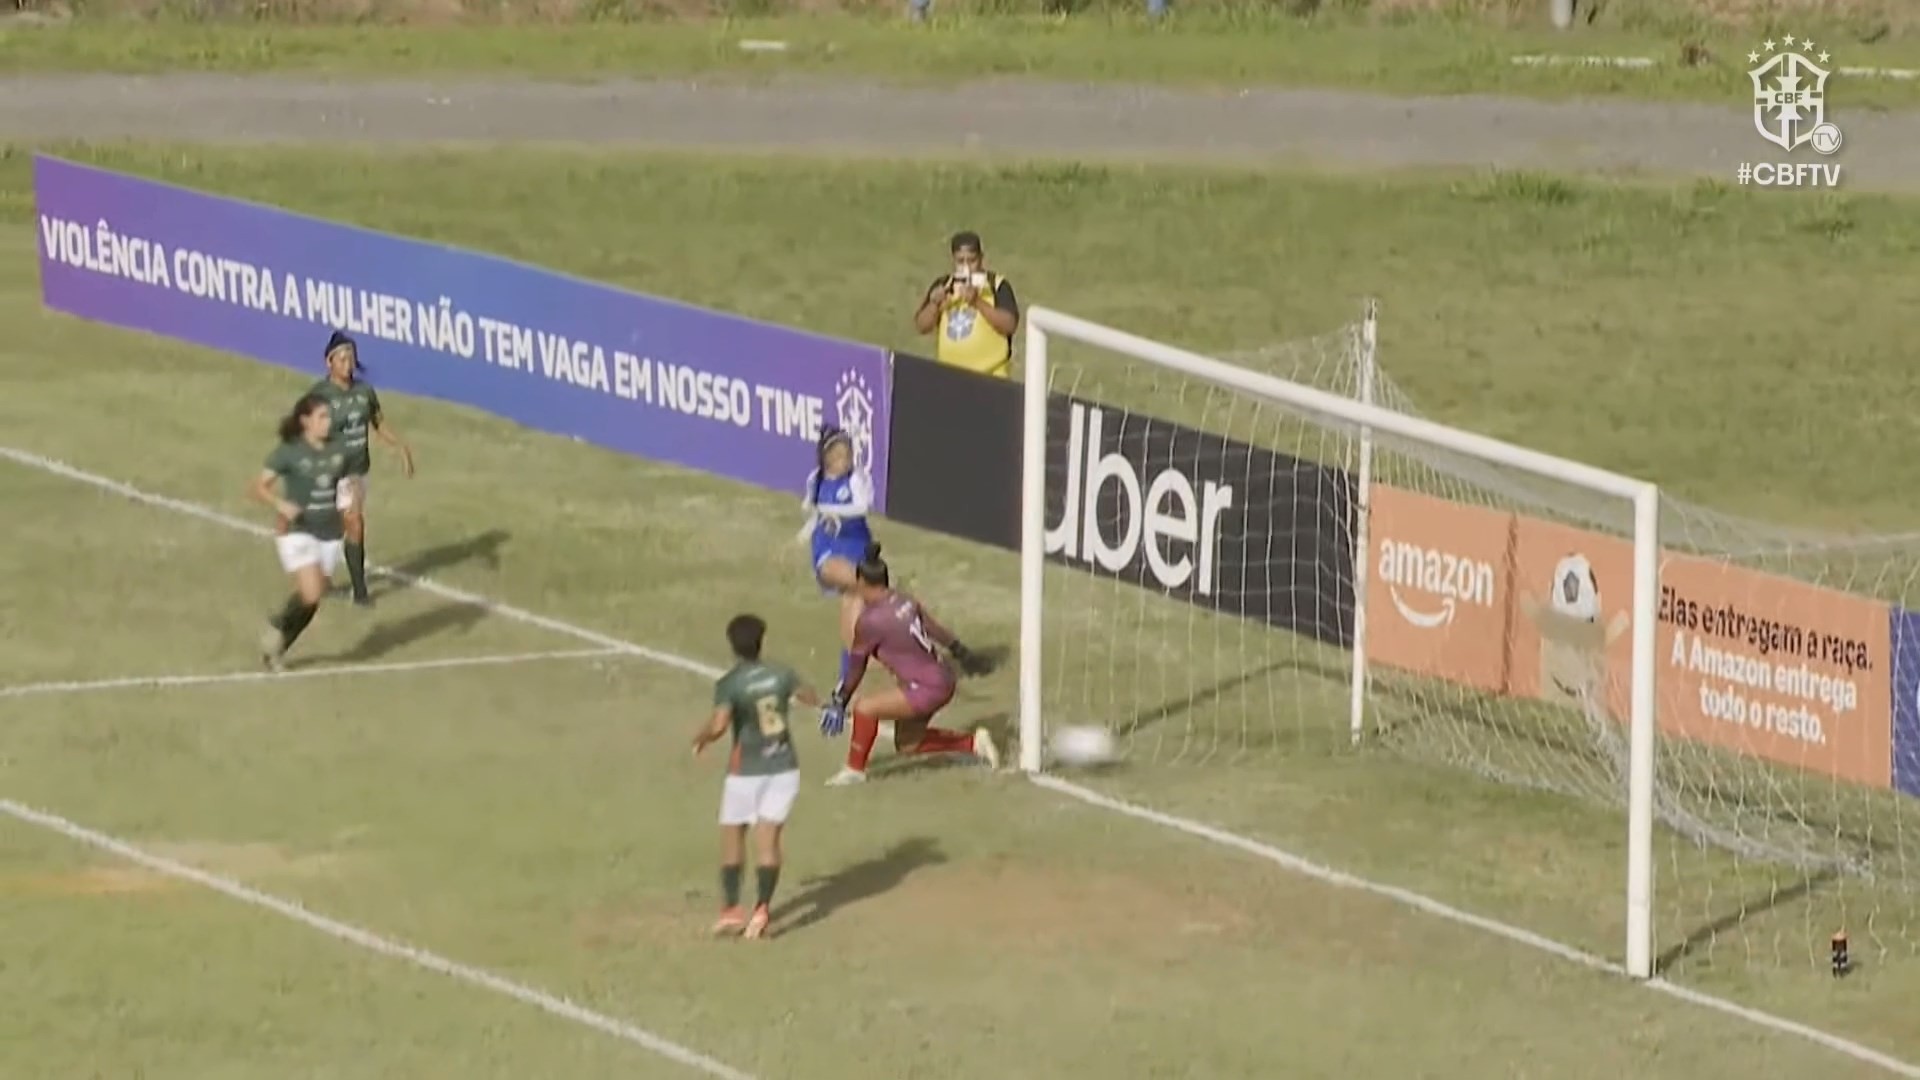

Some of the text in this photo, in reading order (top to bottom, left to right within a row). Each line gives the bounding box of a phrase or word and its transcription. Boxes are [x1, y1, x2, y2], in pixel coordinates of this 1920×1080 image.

[41, 215, 823, 442] VIOLÊNCIA CONTRA A MULHER NÃO TEM VAGA EM NOSSO TIME
[1378, 537, 1494, 608] amazon
[1658, 585, 1698, 631] Elas
[1702, 604, 1802, 656] entregam
[1807, 629, 1818, 659] a
[1671, 630, 1857, 714] A Amazon entrega
[1699, 680, 1827, 745] todo o resto.
